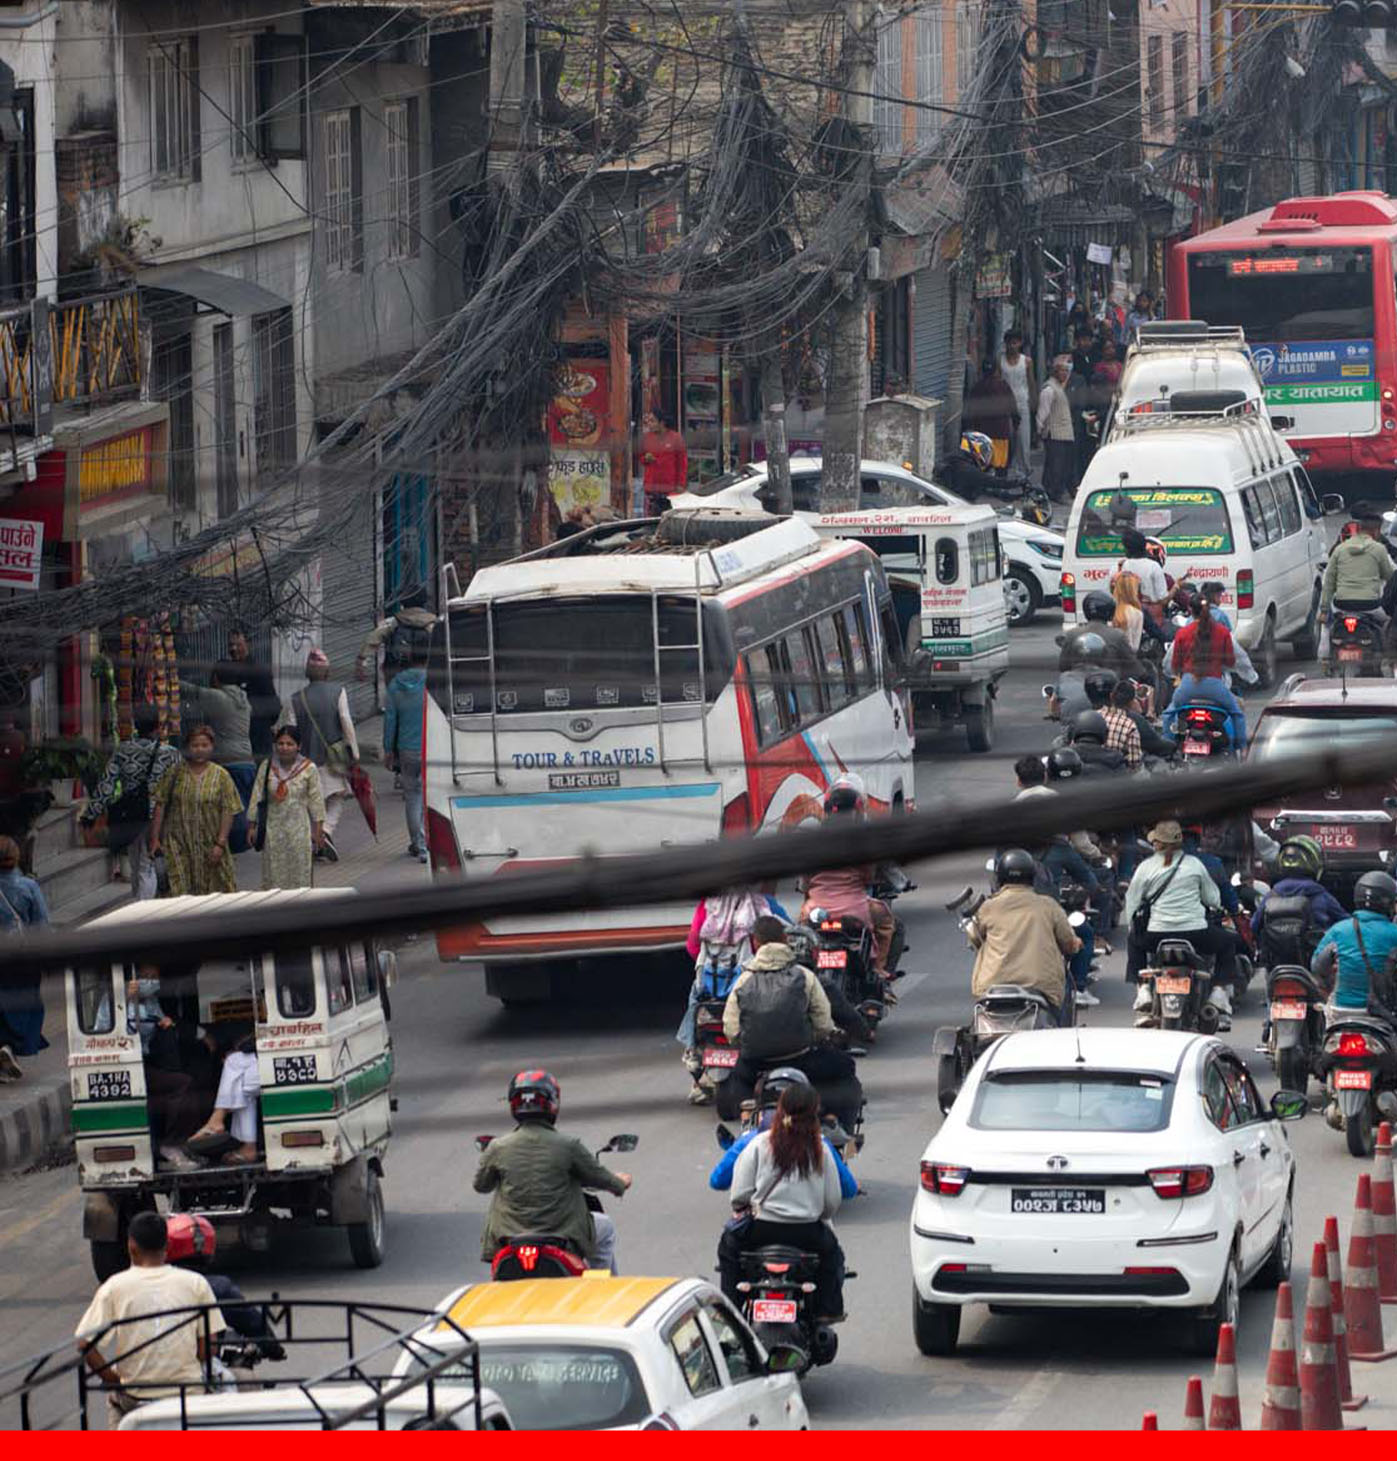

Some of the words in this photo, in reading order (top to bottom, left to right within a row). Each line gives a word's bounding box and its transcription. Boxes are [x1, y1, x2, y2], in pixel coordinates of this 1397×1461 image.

[1278, 351, 1336, 363] JAGADAMBA
[1278, 363, 1316, 374] PLASTIC
[1289, 384, 1363, 399] यातायात
[512, 751, 557, 770] TOUR
[563, 750, 575, 767] &
[89, 1083, 131, 1098] 4392
